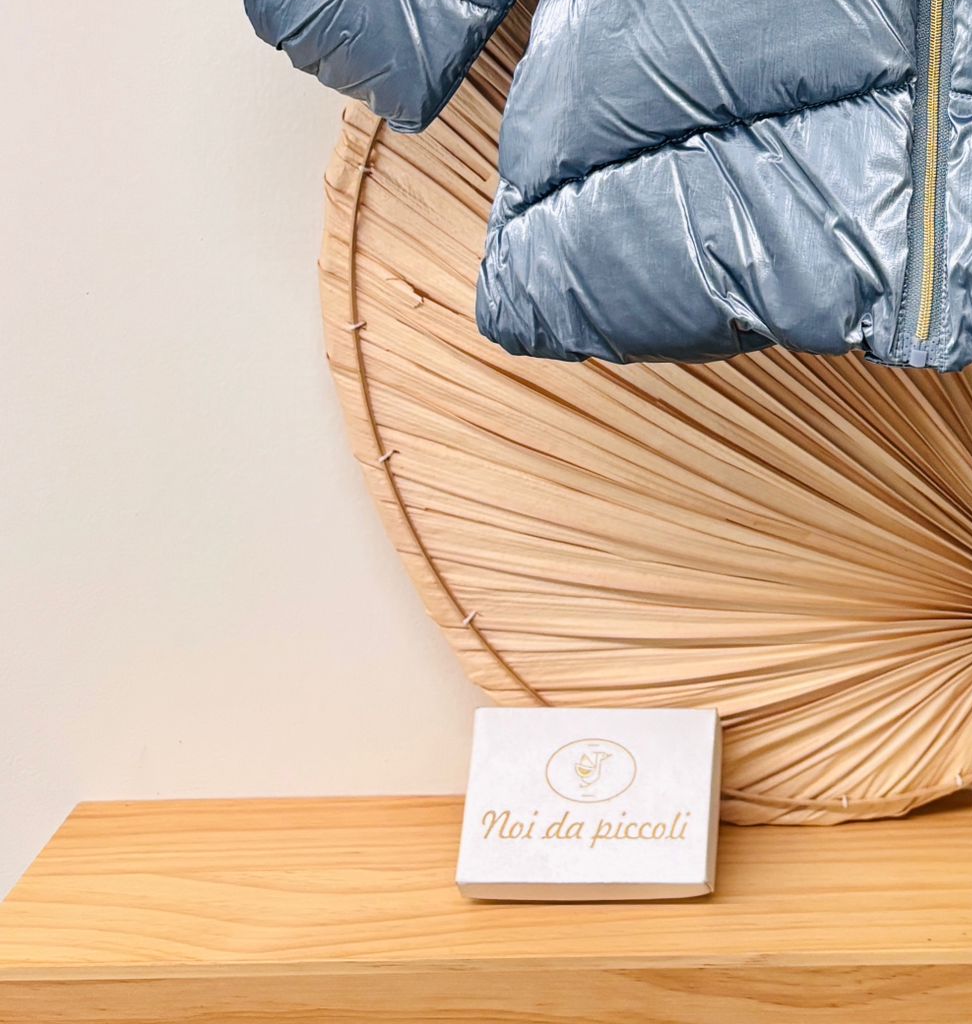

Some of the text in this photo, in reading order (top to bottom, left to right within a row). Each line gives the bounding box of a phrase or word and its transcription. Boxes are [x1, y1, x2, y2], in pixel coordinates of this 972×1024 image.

[481, 809, 692, 849] Noi da piccoli
